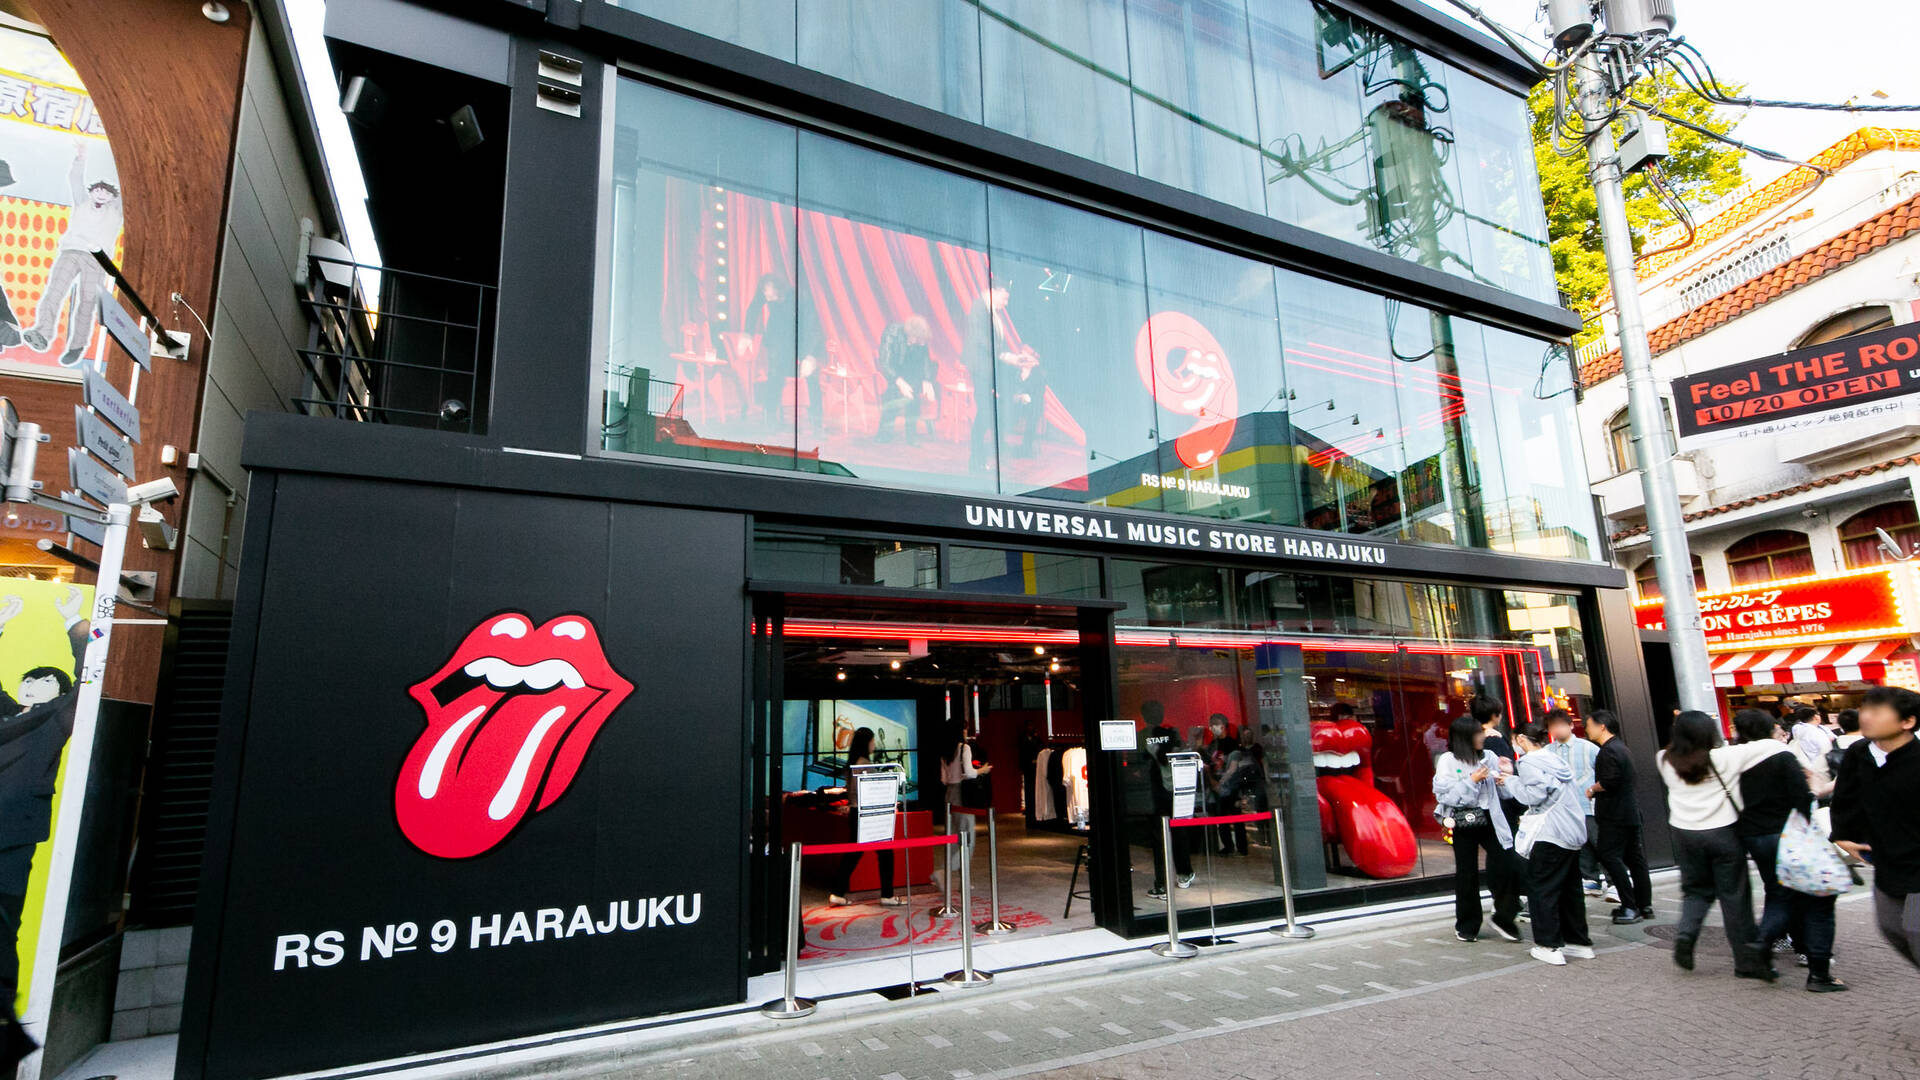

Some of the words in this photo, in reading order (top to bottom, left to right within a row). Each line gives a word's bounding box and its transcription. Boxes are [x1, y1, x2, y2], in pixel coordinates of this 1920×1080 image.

[1690, 371, 1761, 404] Feel
[1769, 352, 1849, 386] THE
[1859, 334, 1920, 369] RO
[1706, 394, 1785, 424] 10/20
[1799, 372, 1888, 404] OPEN
[1141, 473, 1160, 488] RS
[1177, 478, 1186, 491] 9
[1186, 479, 1250, 499] HARAJUKU
[965, 504, 1119, 540] UNIVERSAL
[1127, 521, 1200, 547] MUSIC
[1209, 531, 1274, 554] STORE
[1283, 538, 1387, 564] HARAJUKU
[1726, 628, 1772, 641] Harajuku
[1773, 626, 1799, 638] since
[1800, 622, 1826, 634] 1976
[1737, 602, 1833, 627] CRÊPES
[1145, 735, 1169, 745] STAFF
[273, 930, 345, 971] RS
[430, 918, 456, 953] 9
[469, 892, 702, 949] HARAJUKU
